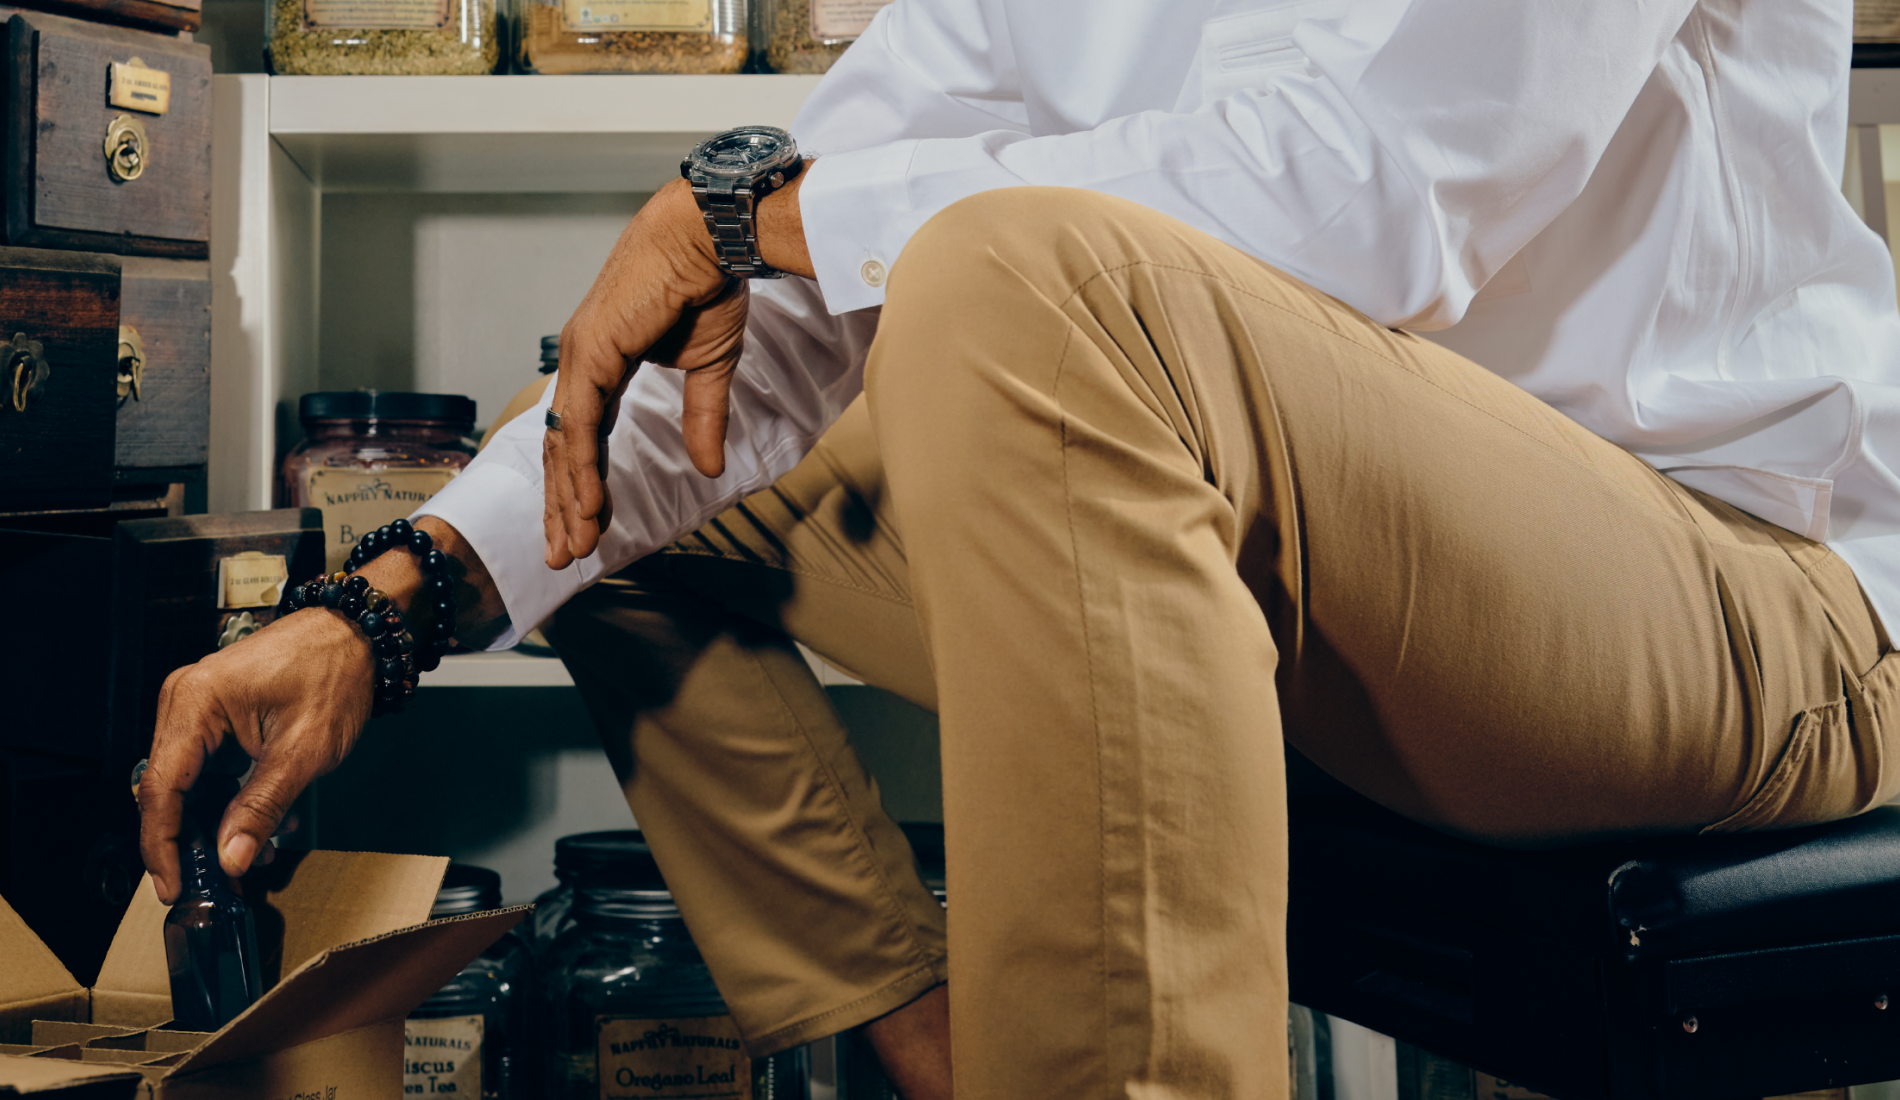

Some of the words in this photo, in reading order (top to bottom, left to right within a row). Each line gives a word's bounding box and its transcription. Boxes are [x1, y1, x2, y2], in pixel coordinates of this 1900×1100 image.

[326, 489, 378, 506] NAPPILY
[383, 489, 434, 503] NATURA
[405, 1036, 471, 1051] NATURALS
[610, 1036, 667, 1055] NAPPILY
[671, 1035, 741, 1050] NATURALS
[405, 1058, 455, 1074] iscus
[404, 1084, 424, 1094] en
[427, 1075, 457, 1093] Tea
[615, 1066, 695, 1091] Oregano
[696, 1063, 736, 1085] Leaf
